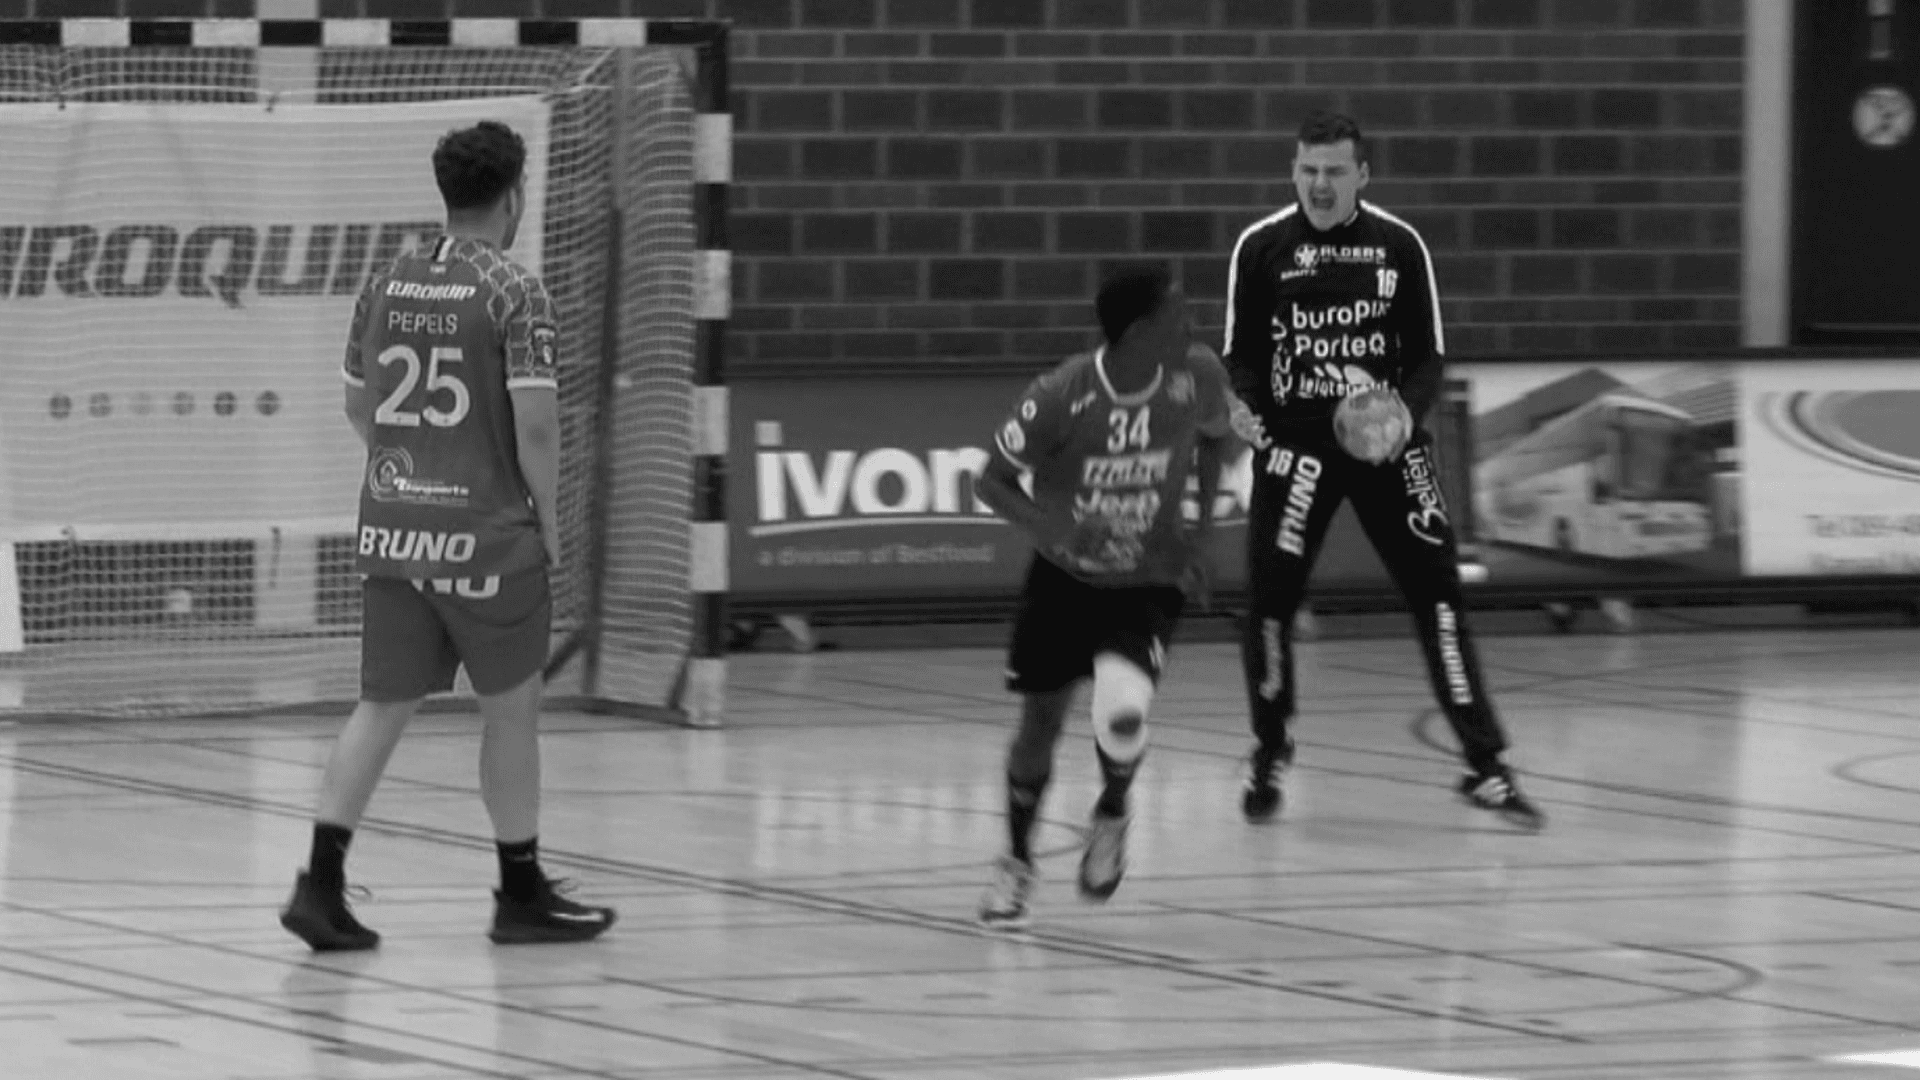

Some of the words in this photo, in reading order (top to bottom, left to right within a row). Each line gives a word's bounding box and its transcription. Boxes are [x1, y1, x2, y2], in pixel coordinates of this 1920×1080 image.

[1376, 269, 1398, 299] 16
[388, 311, 459, 335] PEPELS
[375, 344, 470, 427] 25
[1107, 403, 1151, 453] 34
[1266, 447, 1294, 476] 16
[359, 525, 476, 563] BRUNO
